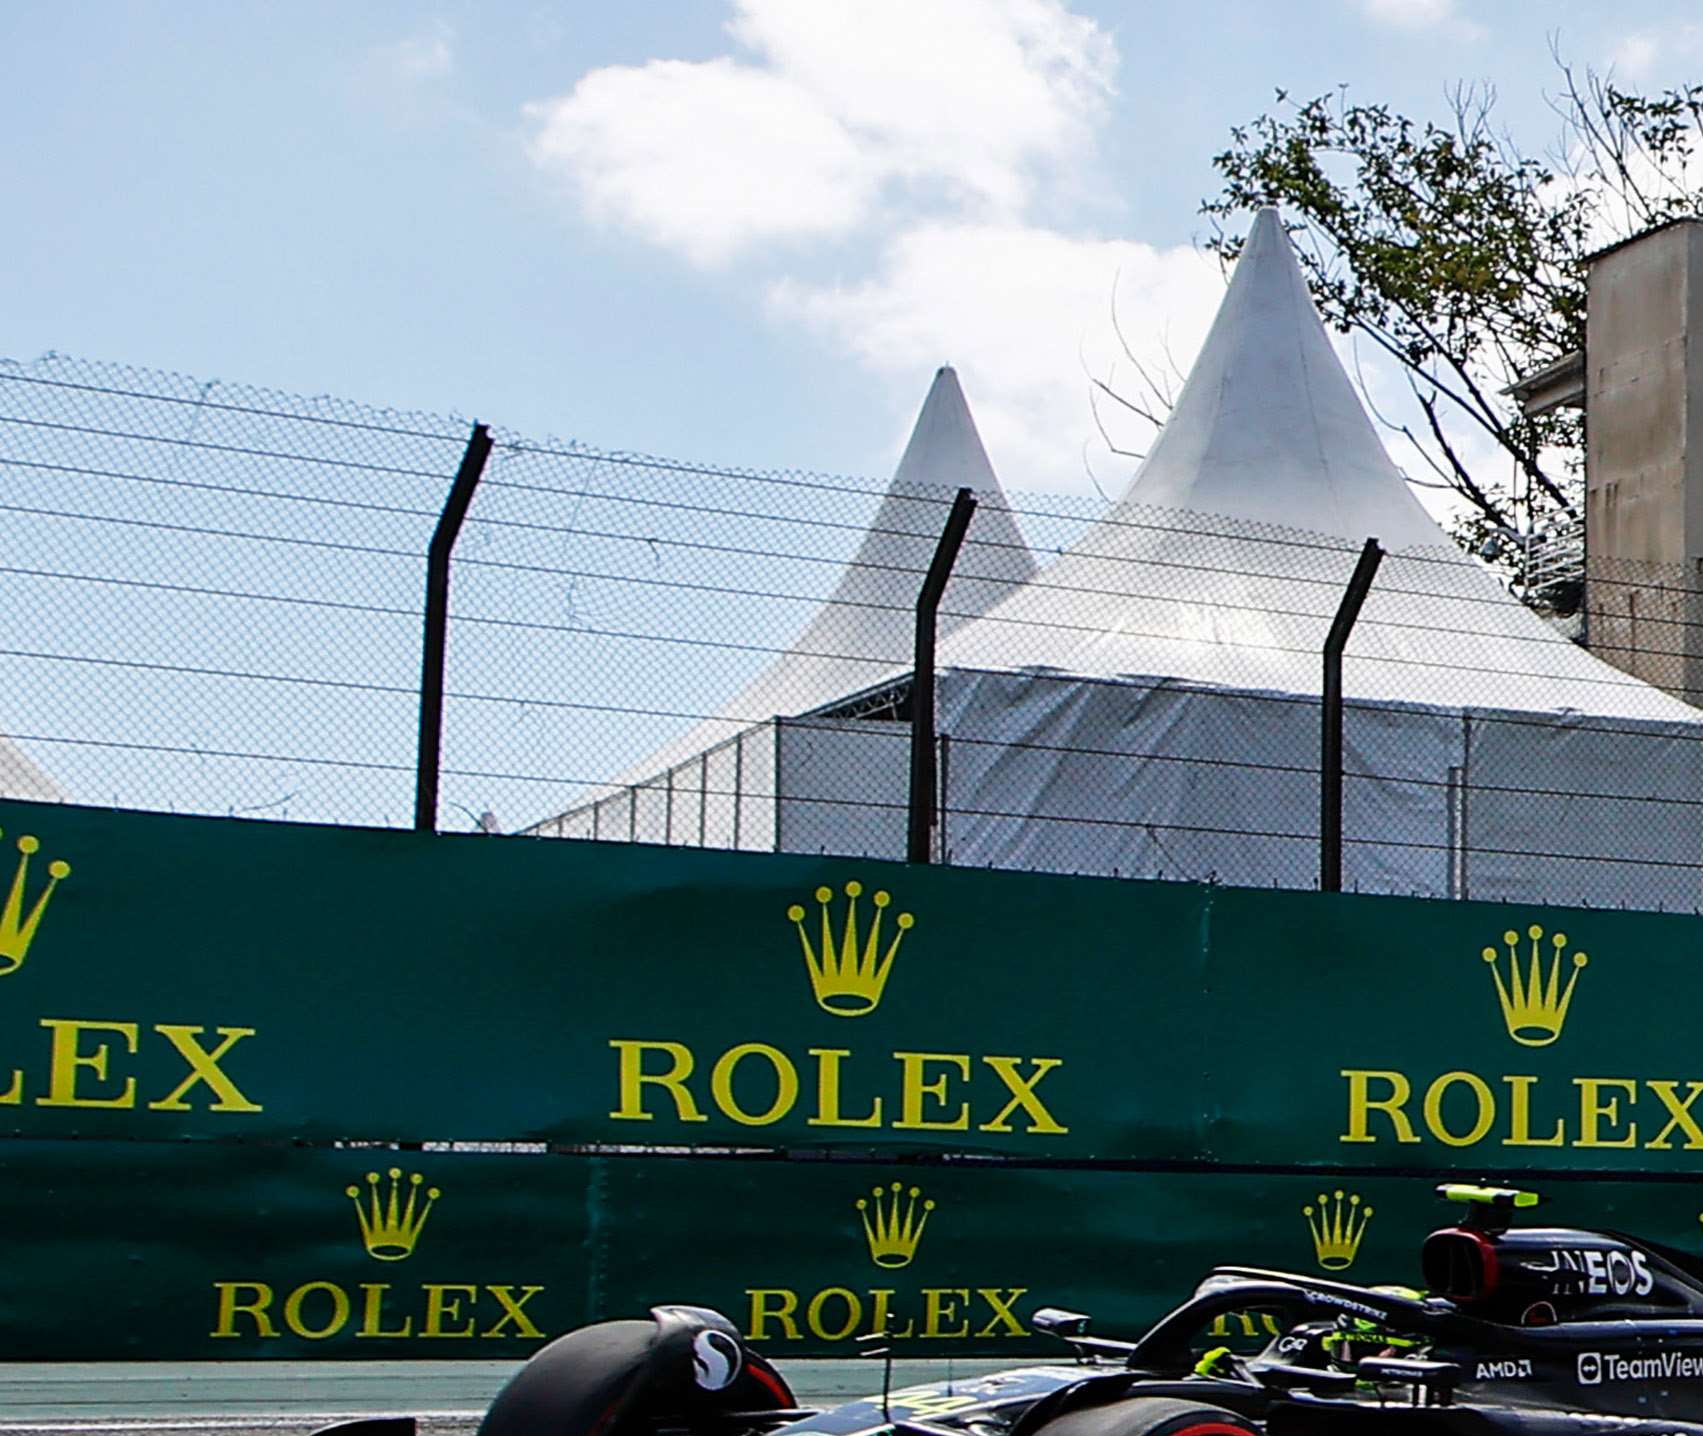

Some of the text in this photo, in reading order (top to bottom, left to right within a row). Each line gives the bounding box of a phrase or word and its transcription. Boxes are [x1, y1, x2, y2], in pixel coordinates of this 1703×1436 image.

[0, 1018, 263, 1112] EX
[608, 1040, 1068, 1134] ROLEX
[1549, 1250, 1654, 1297] INEOS
[210, 1281, 546, 1339] ROLEX
[746, 1286, 1031, 1340] ROLEX
[1475, 1361, 1520, 1380] AMD
